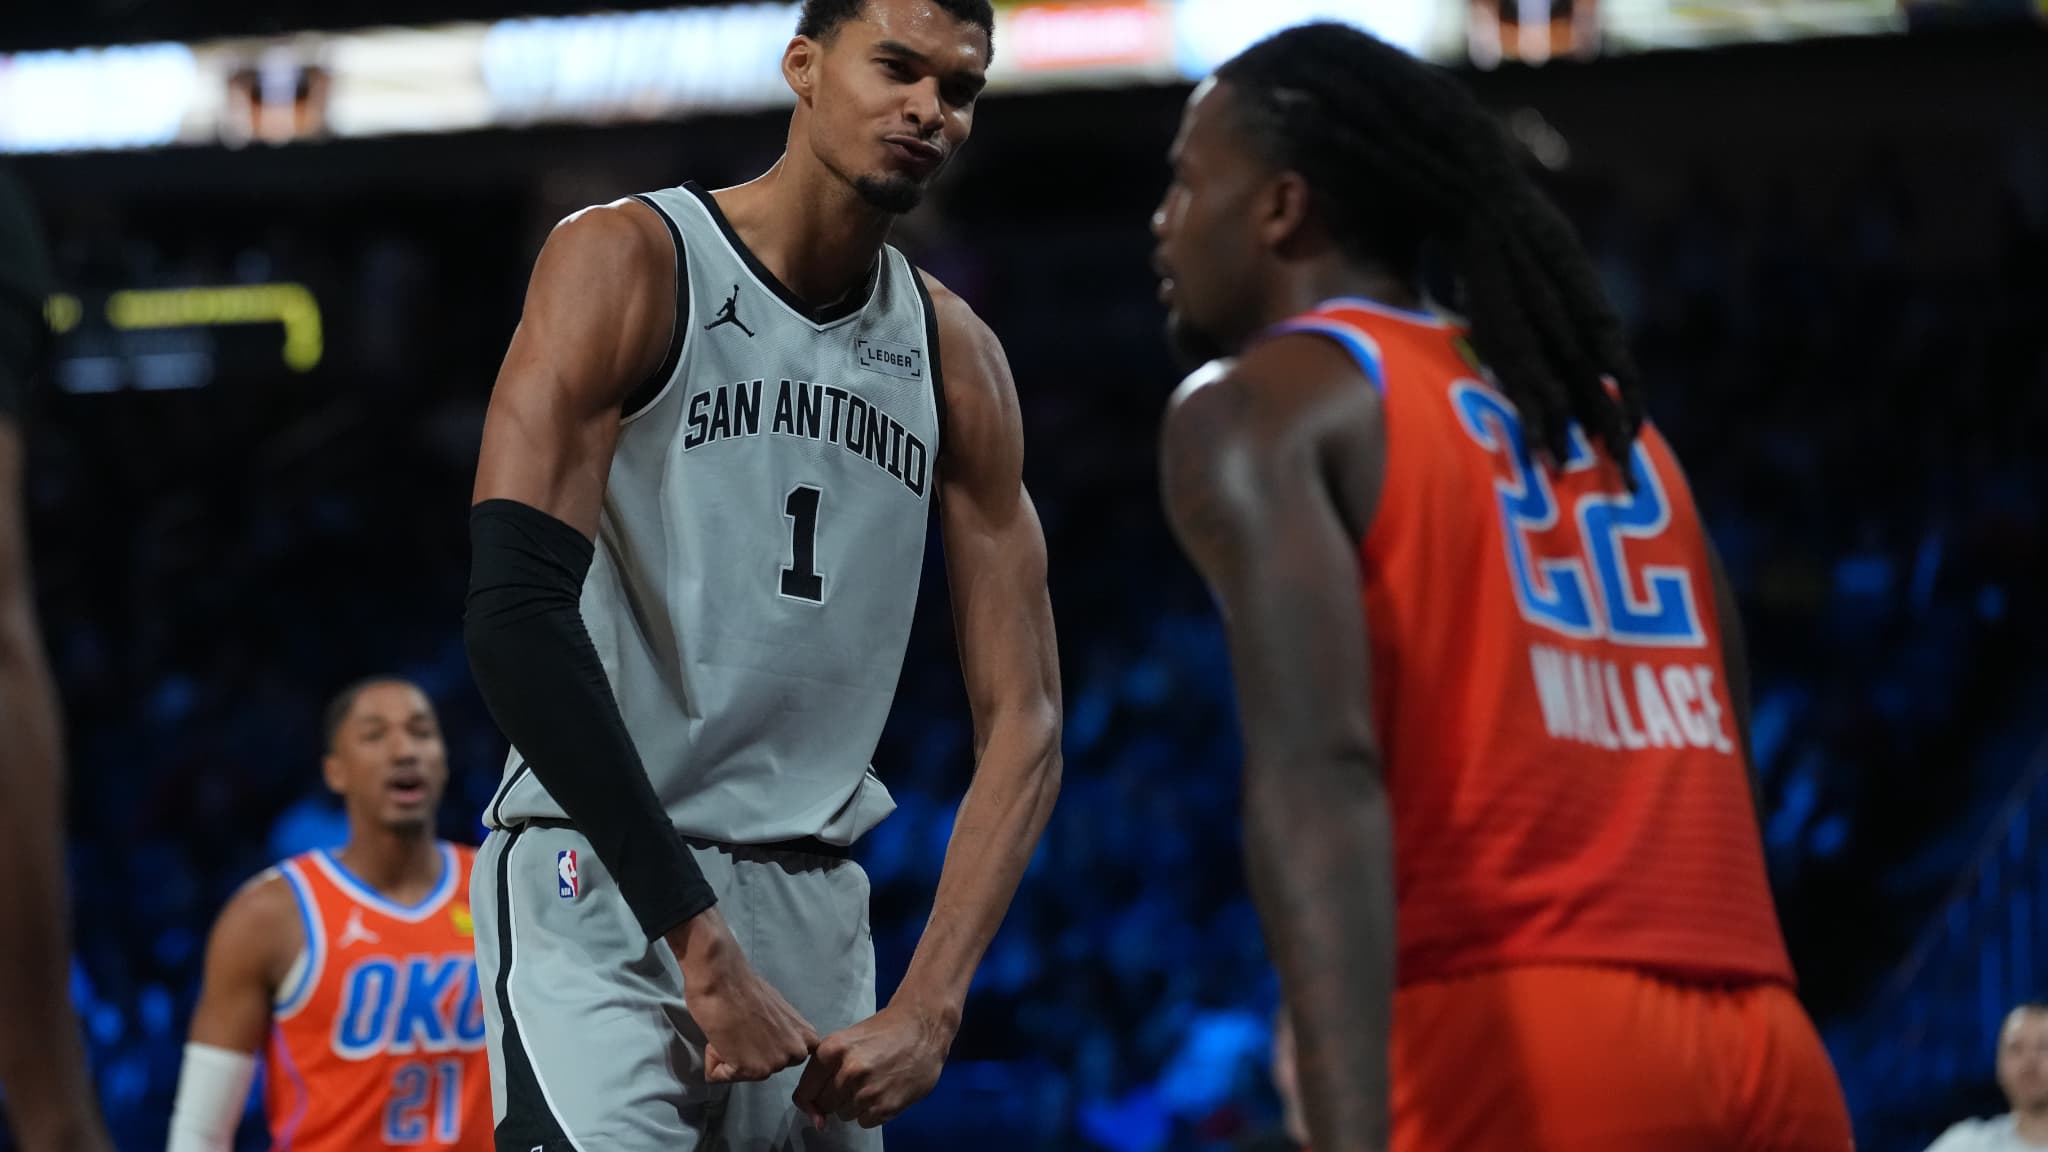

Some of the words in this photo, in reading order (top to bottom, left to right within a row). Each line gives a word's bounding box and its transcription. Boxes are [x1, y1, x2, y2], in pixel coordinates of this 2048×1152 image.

[867, 348, 912, 368] LEDGER
[683, 378, 765, 453] SAN
[770, 379, 928, 503] ANTONIO
[778, 483, 825, 605] 1
[1449, 370, 1707, 648] 22
[1530, 643, 1734, 754] WALLACE
[381, 1058, 464, 1146] 21
